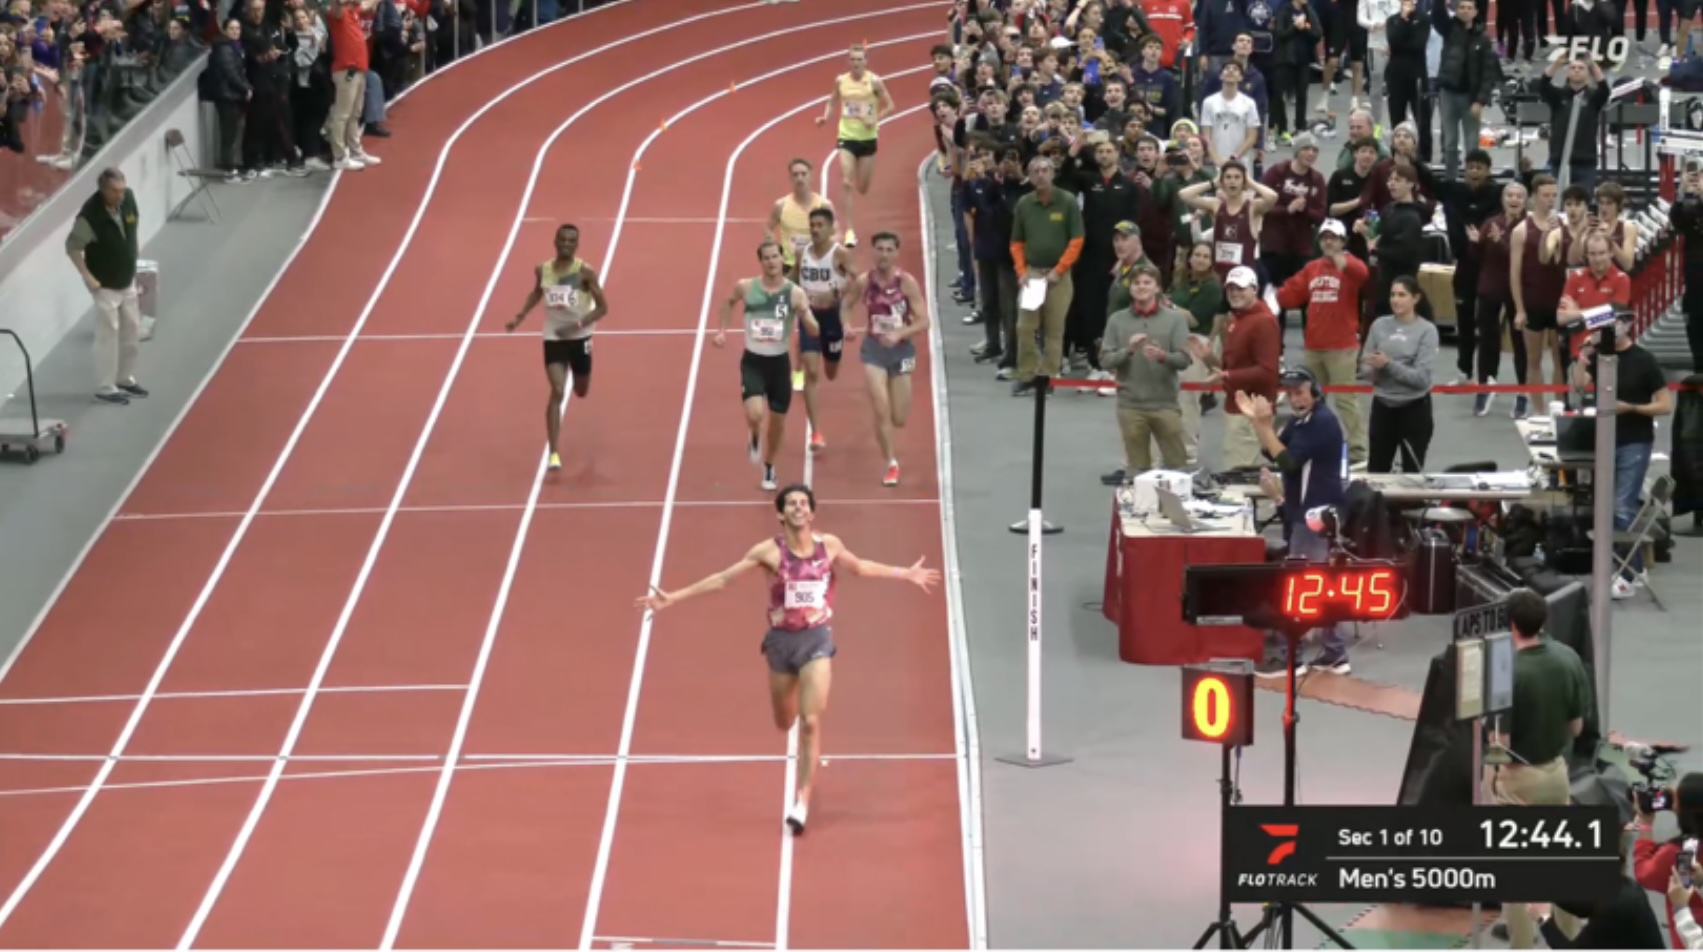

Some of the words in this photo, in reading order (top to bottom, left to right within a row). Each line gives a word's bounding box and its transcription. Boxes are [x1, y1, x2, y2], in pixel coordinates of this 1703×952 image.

[801, 266, 831, 282] CBU
[794, 591, 815, 603] 905
[1030, 543, 1039, 641] FINISH
[1456, 611, 1481, 638] LAPS
[1193, 677, 1230, 738] 0
